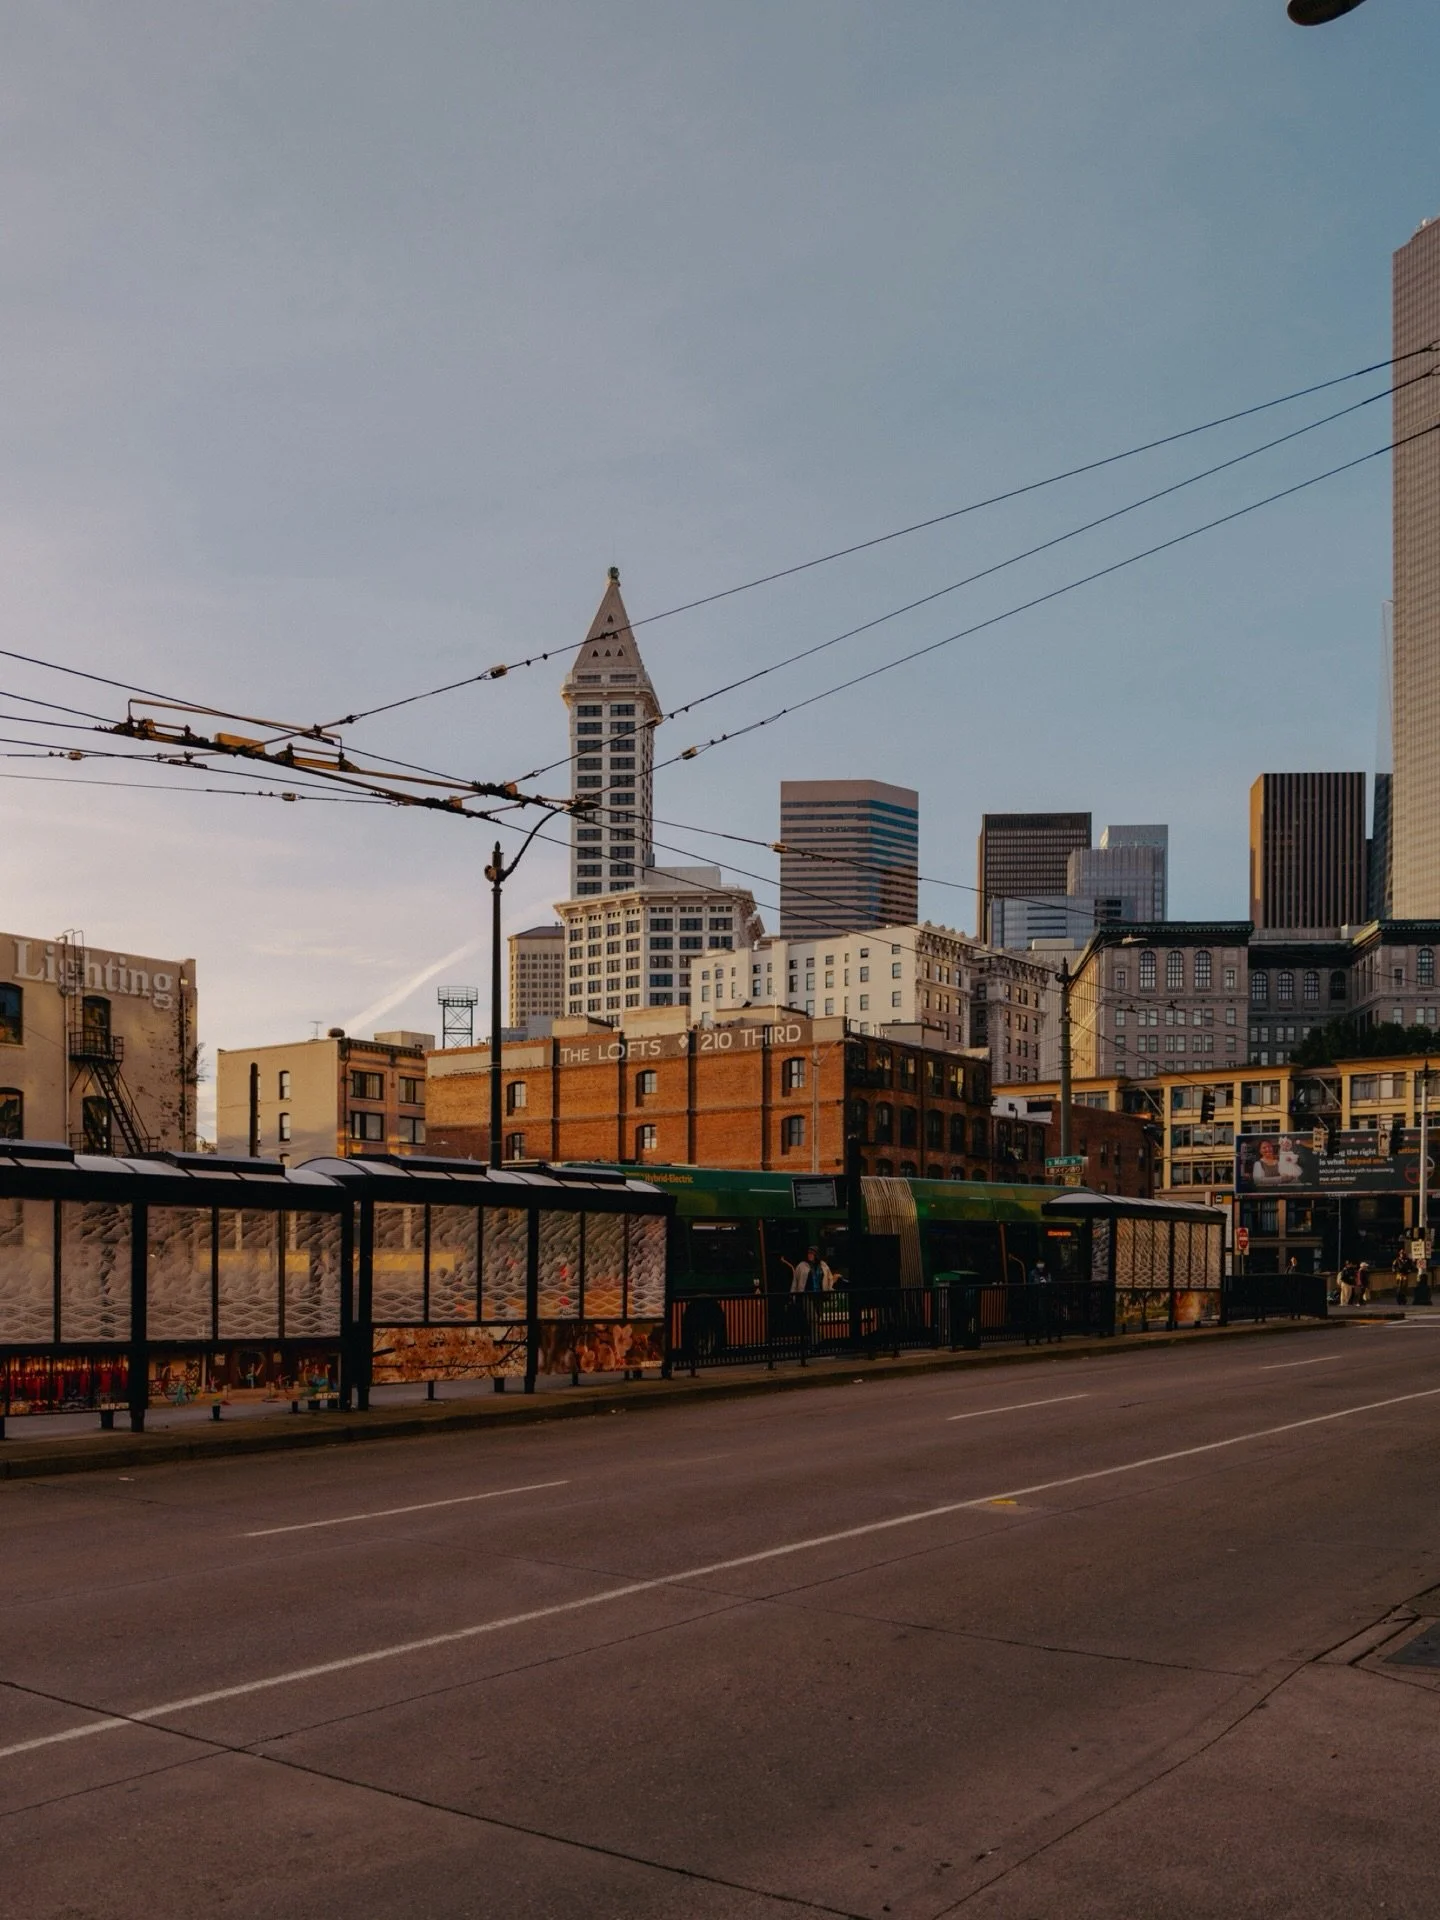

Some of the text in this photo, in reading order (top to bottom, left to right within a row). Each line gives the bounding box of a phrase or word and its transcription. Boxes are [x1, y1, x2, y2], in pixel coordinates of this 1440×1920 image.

[14, 939, 173, 1009] Lighting
[561, 1024, 801, 1062] THE LOFTS 210 THIRD
[1326, 1158, 1345, 1166] what
[645, 1172, 694, 1185] Hybrid-Electric
